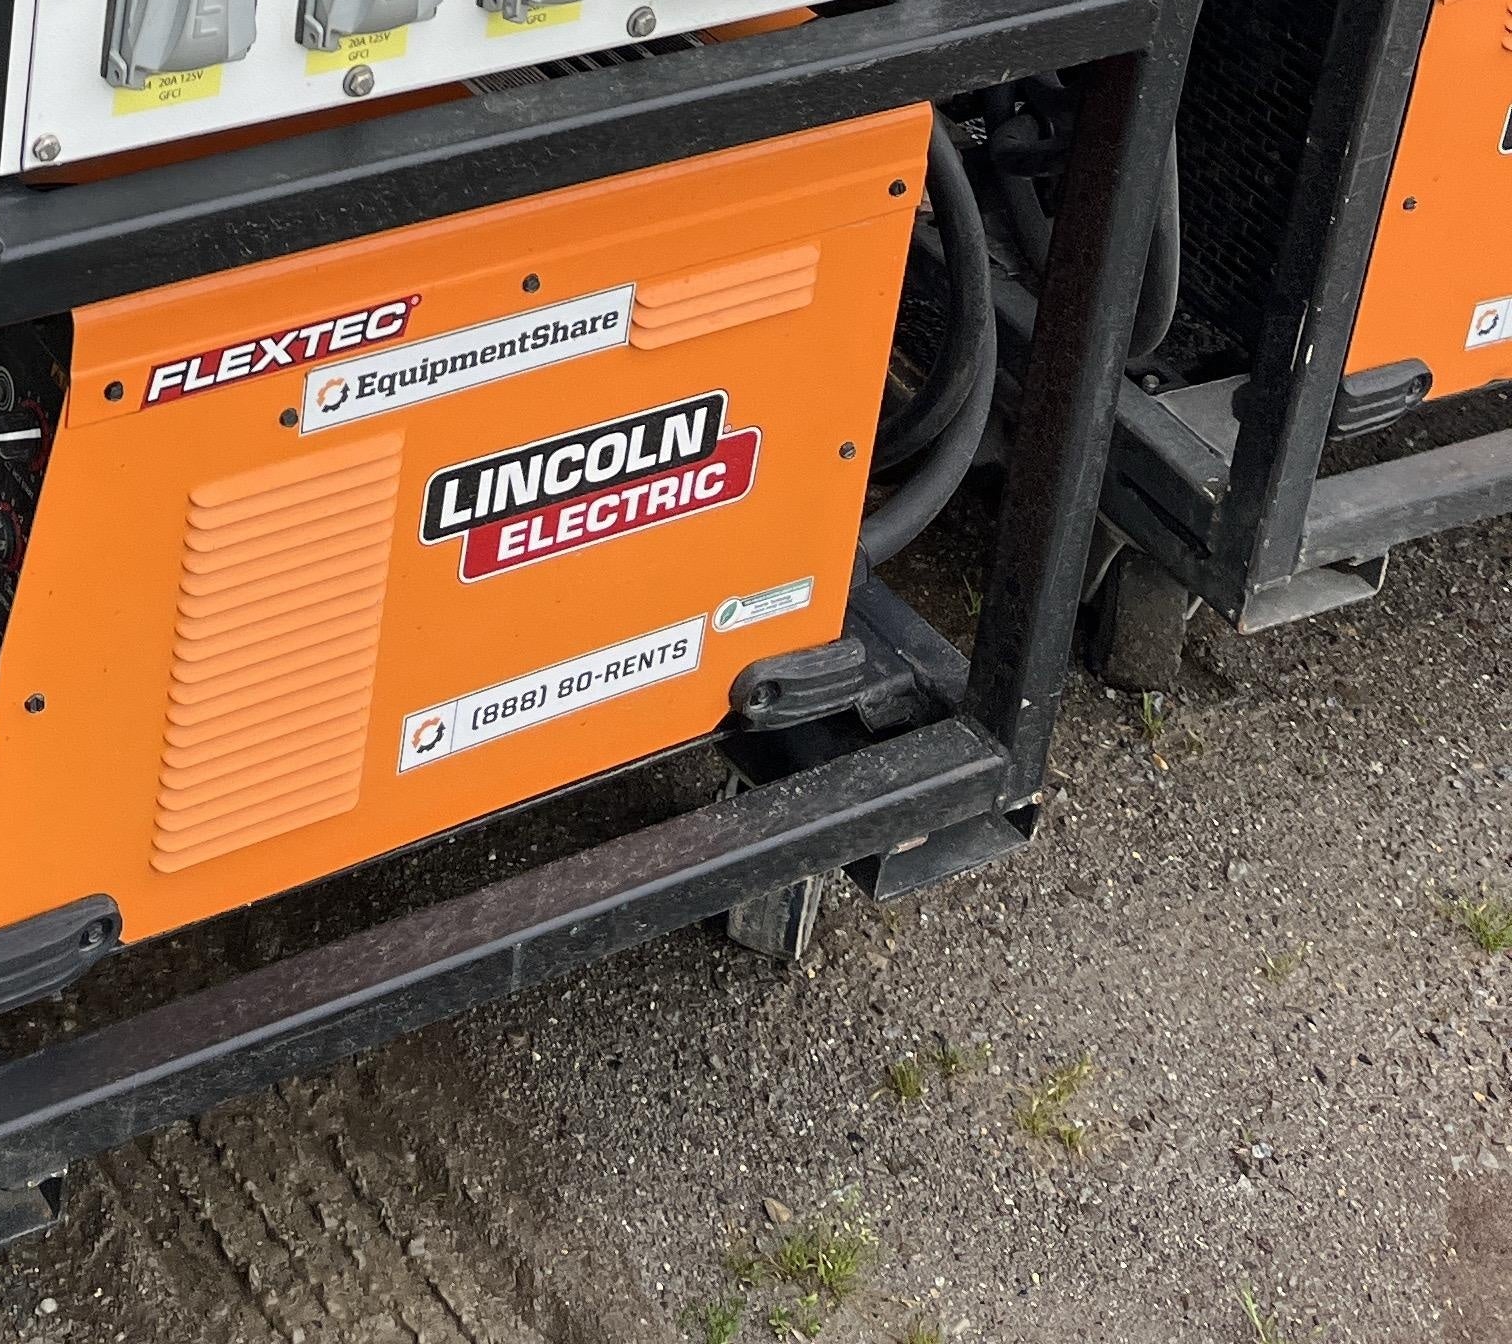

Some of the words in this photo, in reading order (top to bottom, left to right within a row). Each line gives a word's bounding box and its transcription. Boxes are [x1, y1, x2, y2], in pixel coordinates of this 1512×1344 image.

[159, 75, 178, 88] 20A
[180, 70, 205, 83] 125V
[348, 36, 367, 48] 20A
[368, 31, 392, 44] 125V
[348, 49, 370, 62] GFCI
[158, 89, 183, 102] GFCI
[147, 299, 407, 403] FLEXTEC
[355, 307, 620, 400] EquipmentShare
[440, 407, 709, 527] LINCOLN
[496, 461, 727, 562] ELECTRIC
[470, 687, 548, 733] (888)
[557, 637, 689, 702] 80-RENTS
